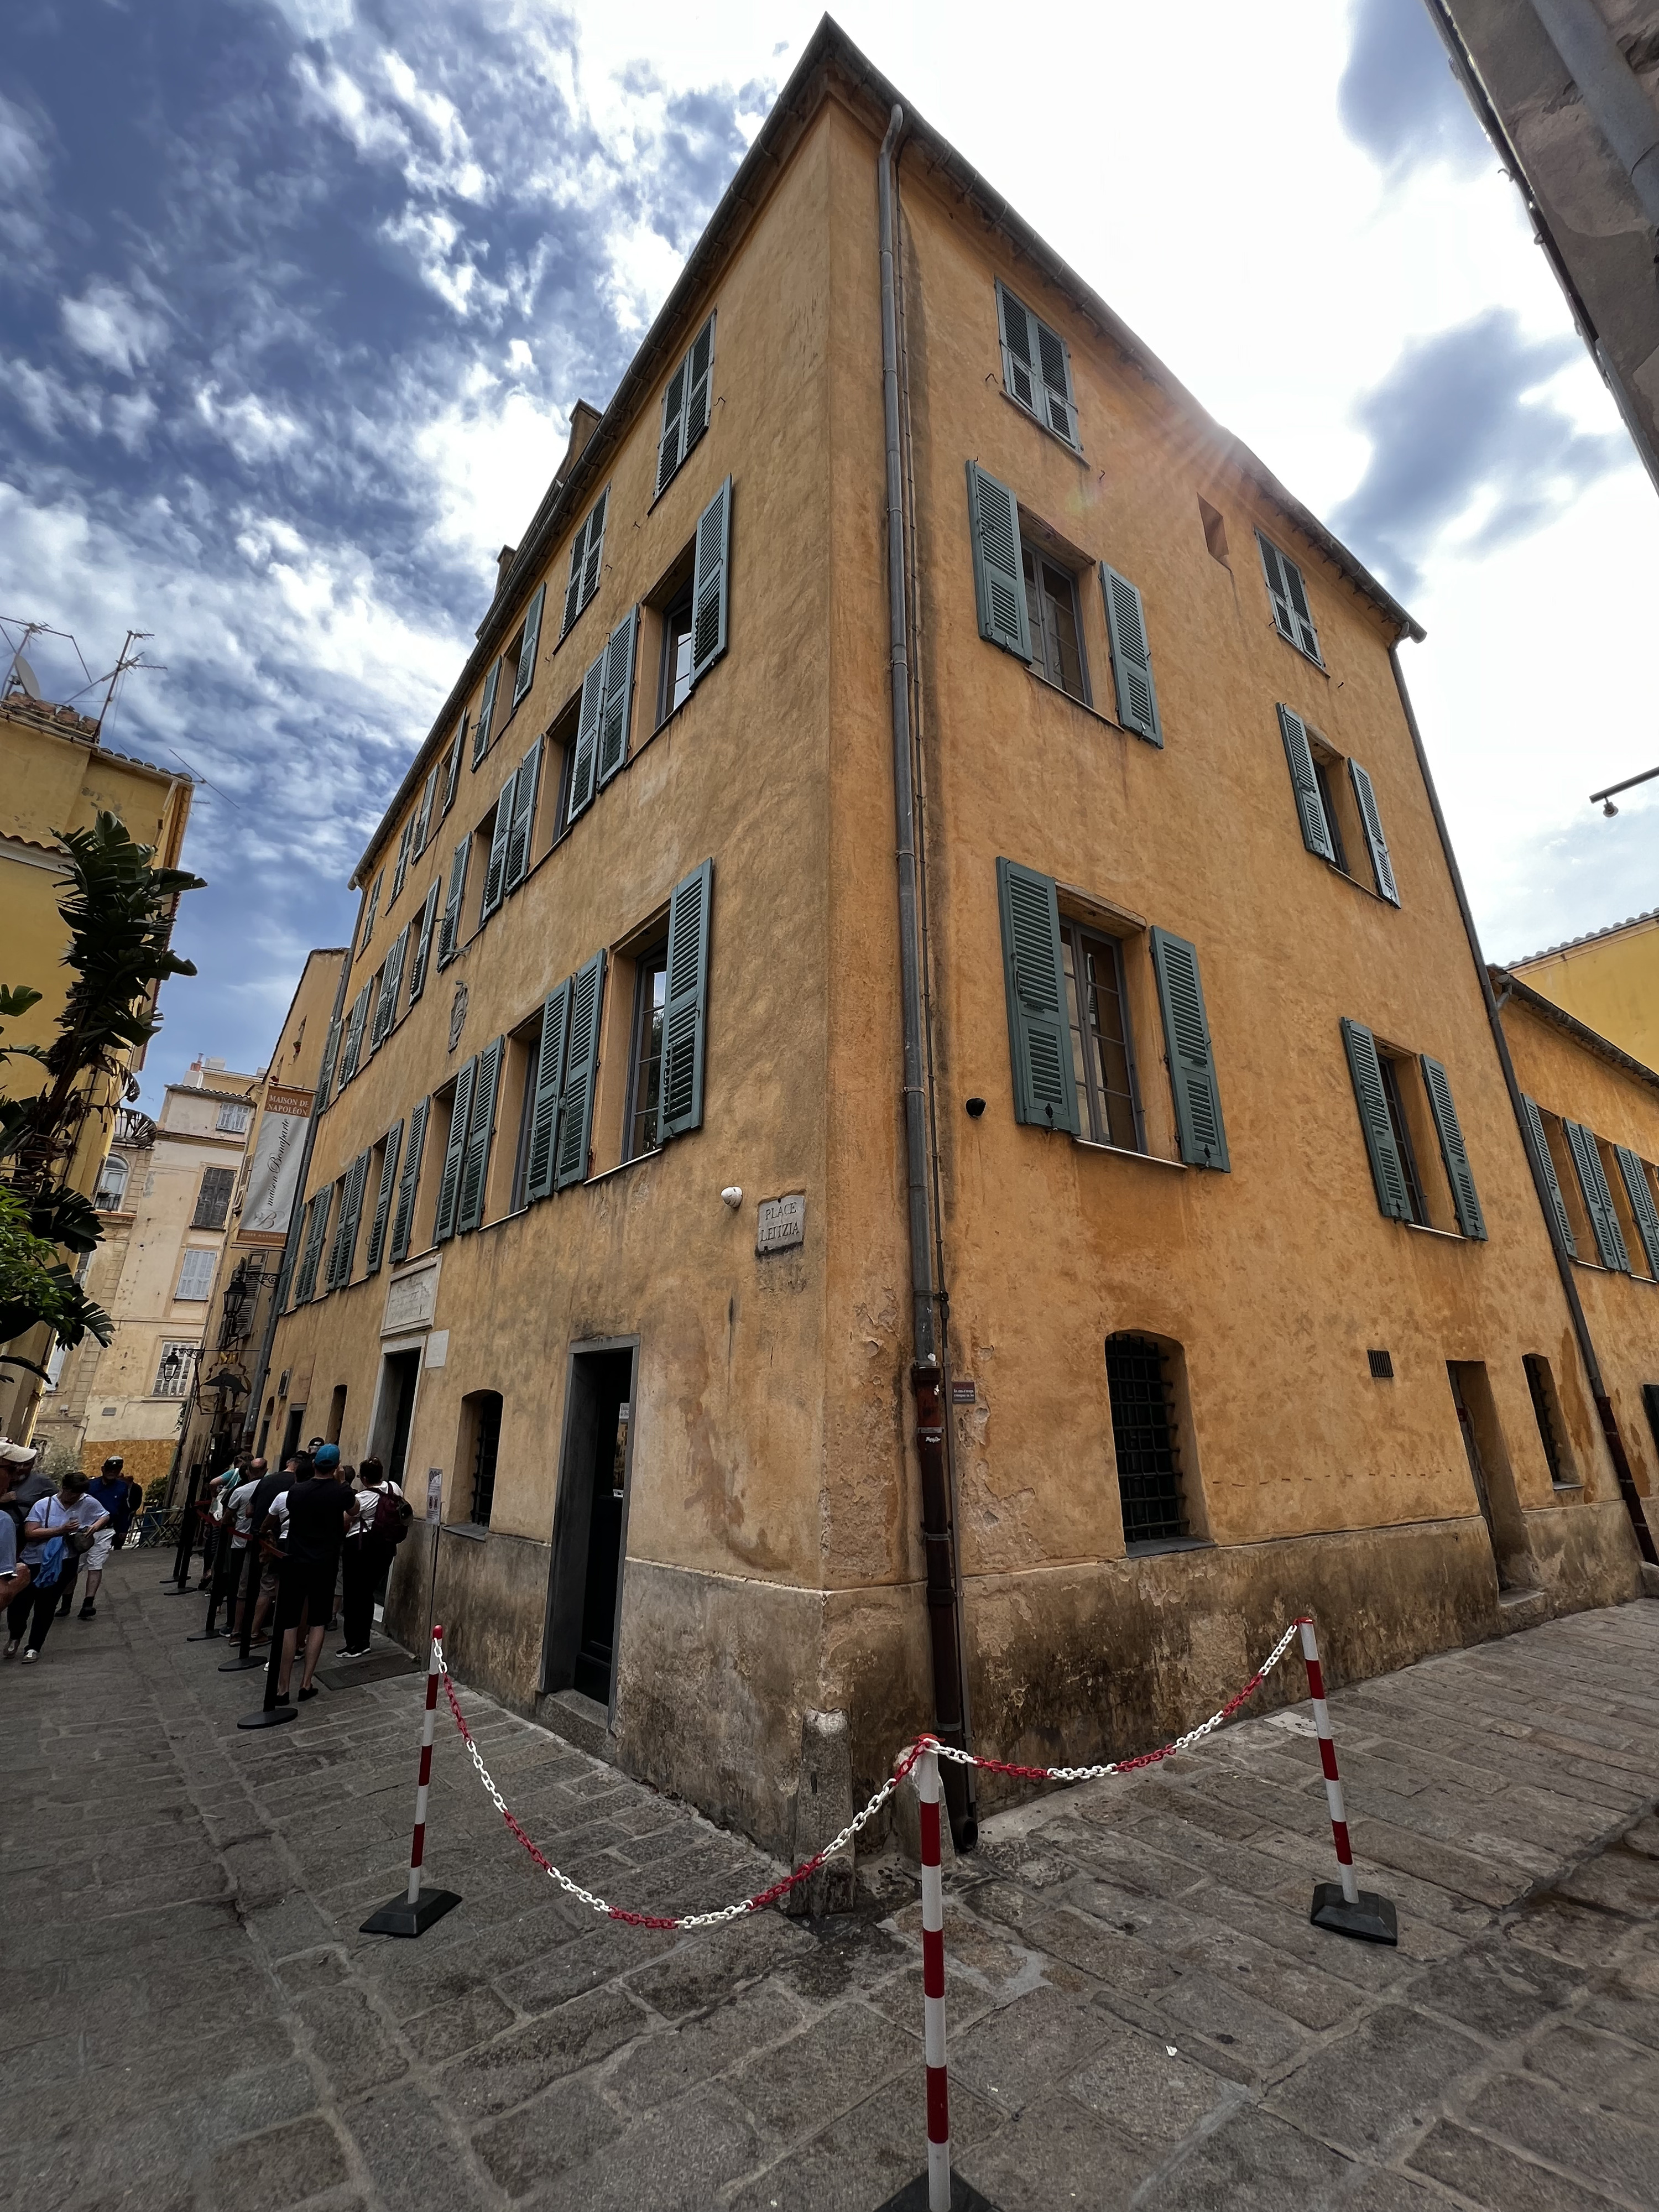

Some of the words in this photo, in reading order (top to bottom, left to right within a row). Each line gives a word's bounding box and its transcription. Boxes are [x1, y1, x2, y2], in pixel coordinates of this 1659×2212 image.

[267, 1104, 307, 1115] NAPOLÉON
[269, 1095, 298, 1105] MAISON
[299, 1100, 310, 1108] DE
[267, 1118, 290, 1173] Bonaparte
[268, 1176, 278, 1207] maison
[765, 1202, 797, 1220] PLACE
[760, 1222, 800, 1242] LETIZIA
